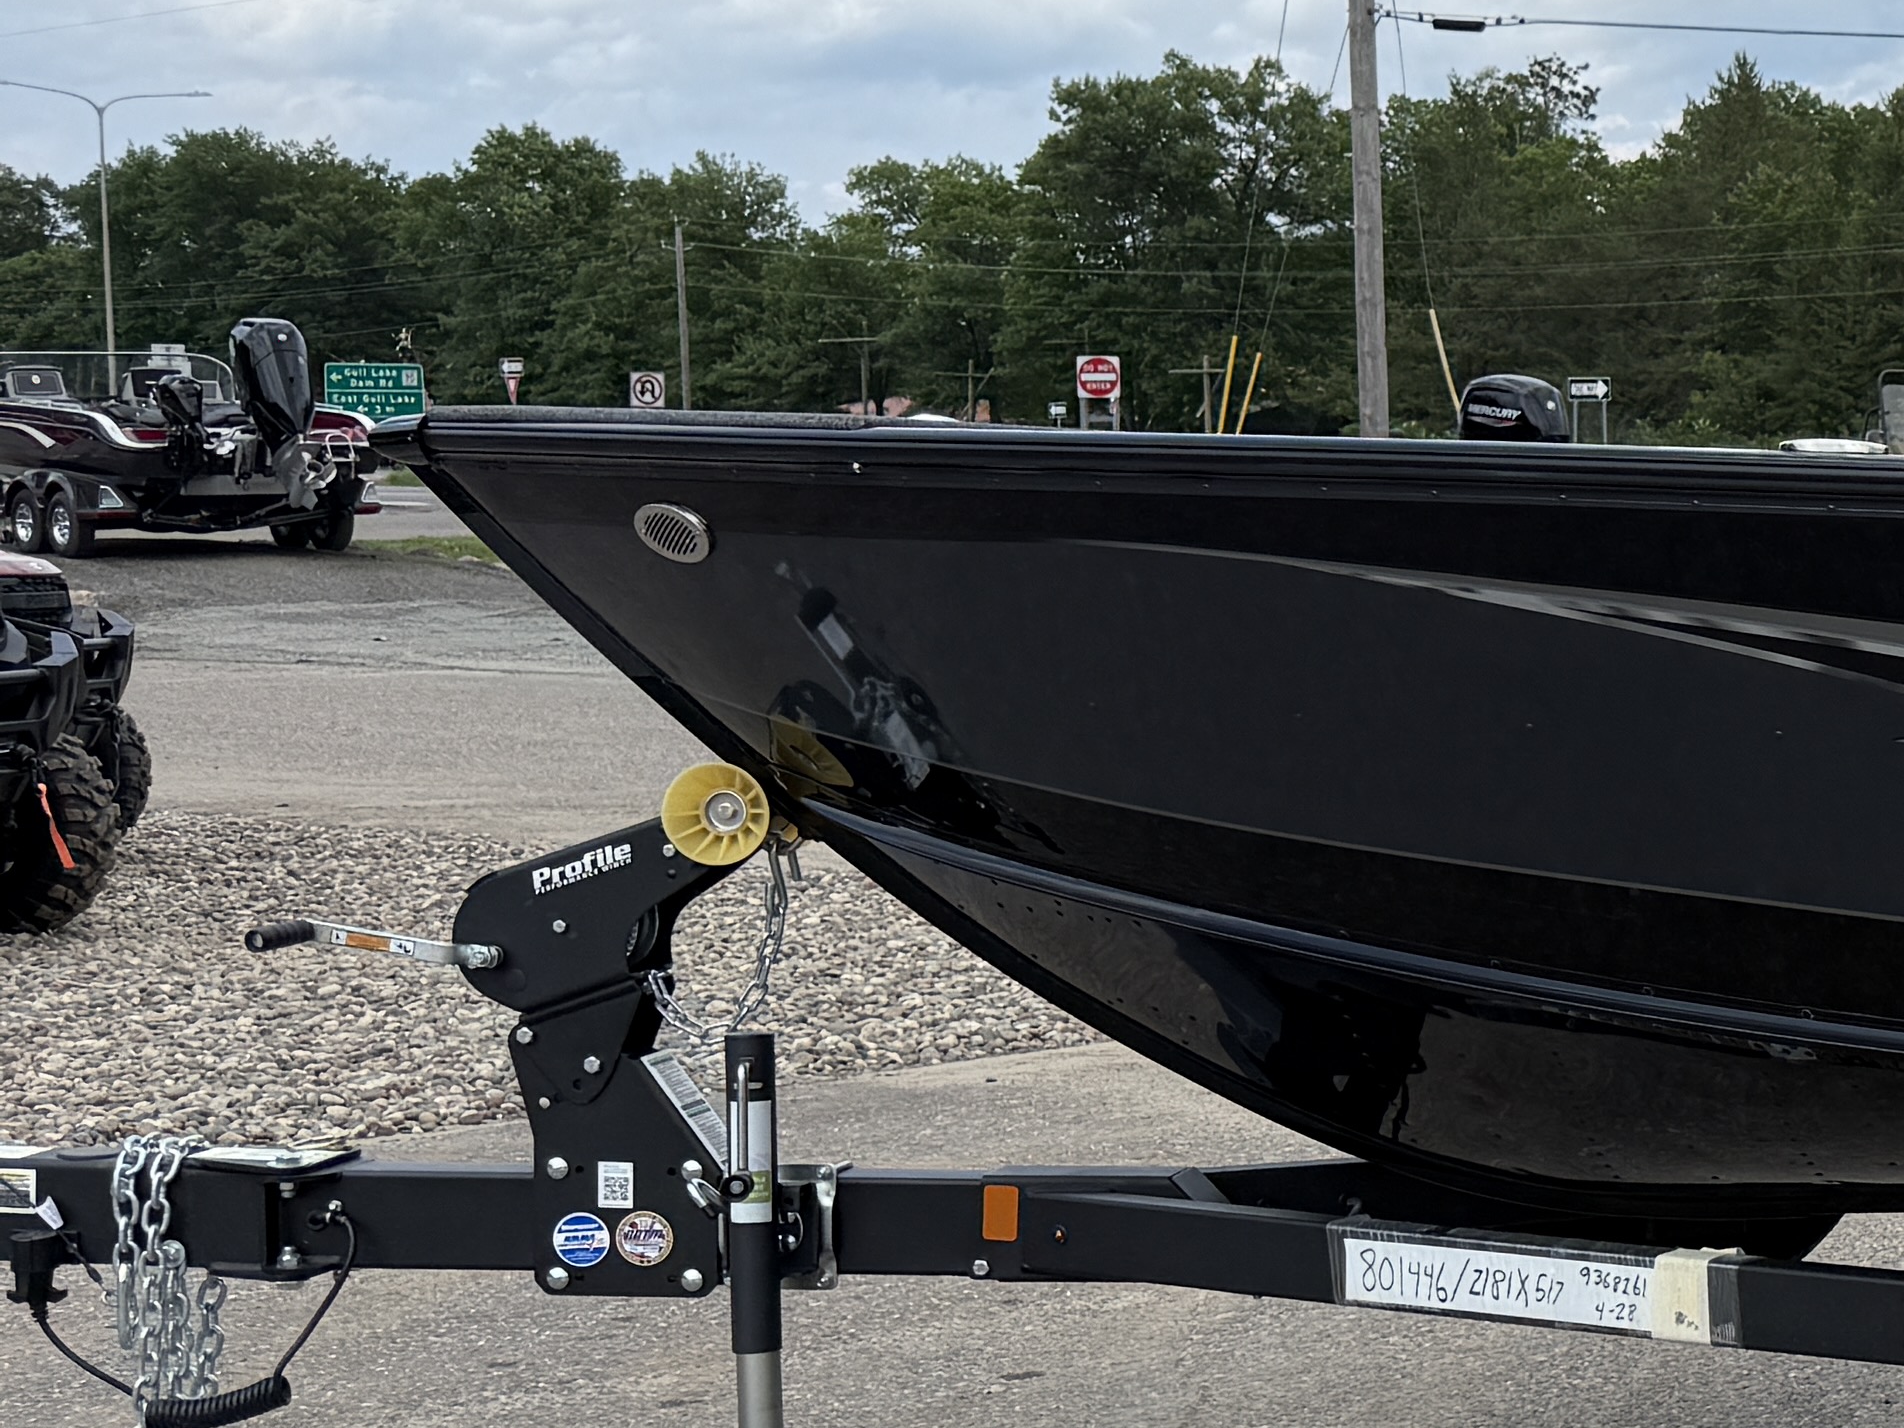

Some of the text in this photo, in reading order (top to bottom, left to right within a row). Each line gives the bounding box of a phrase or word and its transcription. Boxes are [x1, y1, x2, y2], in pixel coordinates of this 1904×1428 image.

[344, 368, 397, 377] Gull Lake
[350, 379, 375, 387] Dam
[332, 394, 357, 403] East
[363, 394, 385, 403] Gull
[1467, 403, 1522, 421] MERCURY
[532, 843, 632, 890] Profile
[535, 858, 632, 895] PERFORMANCE WINCH
[1595, 1301, 1638, 1322] 4-28
